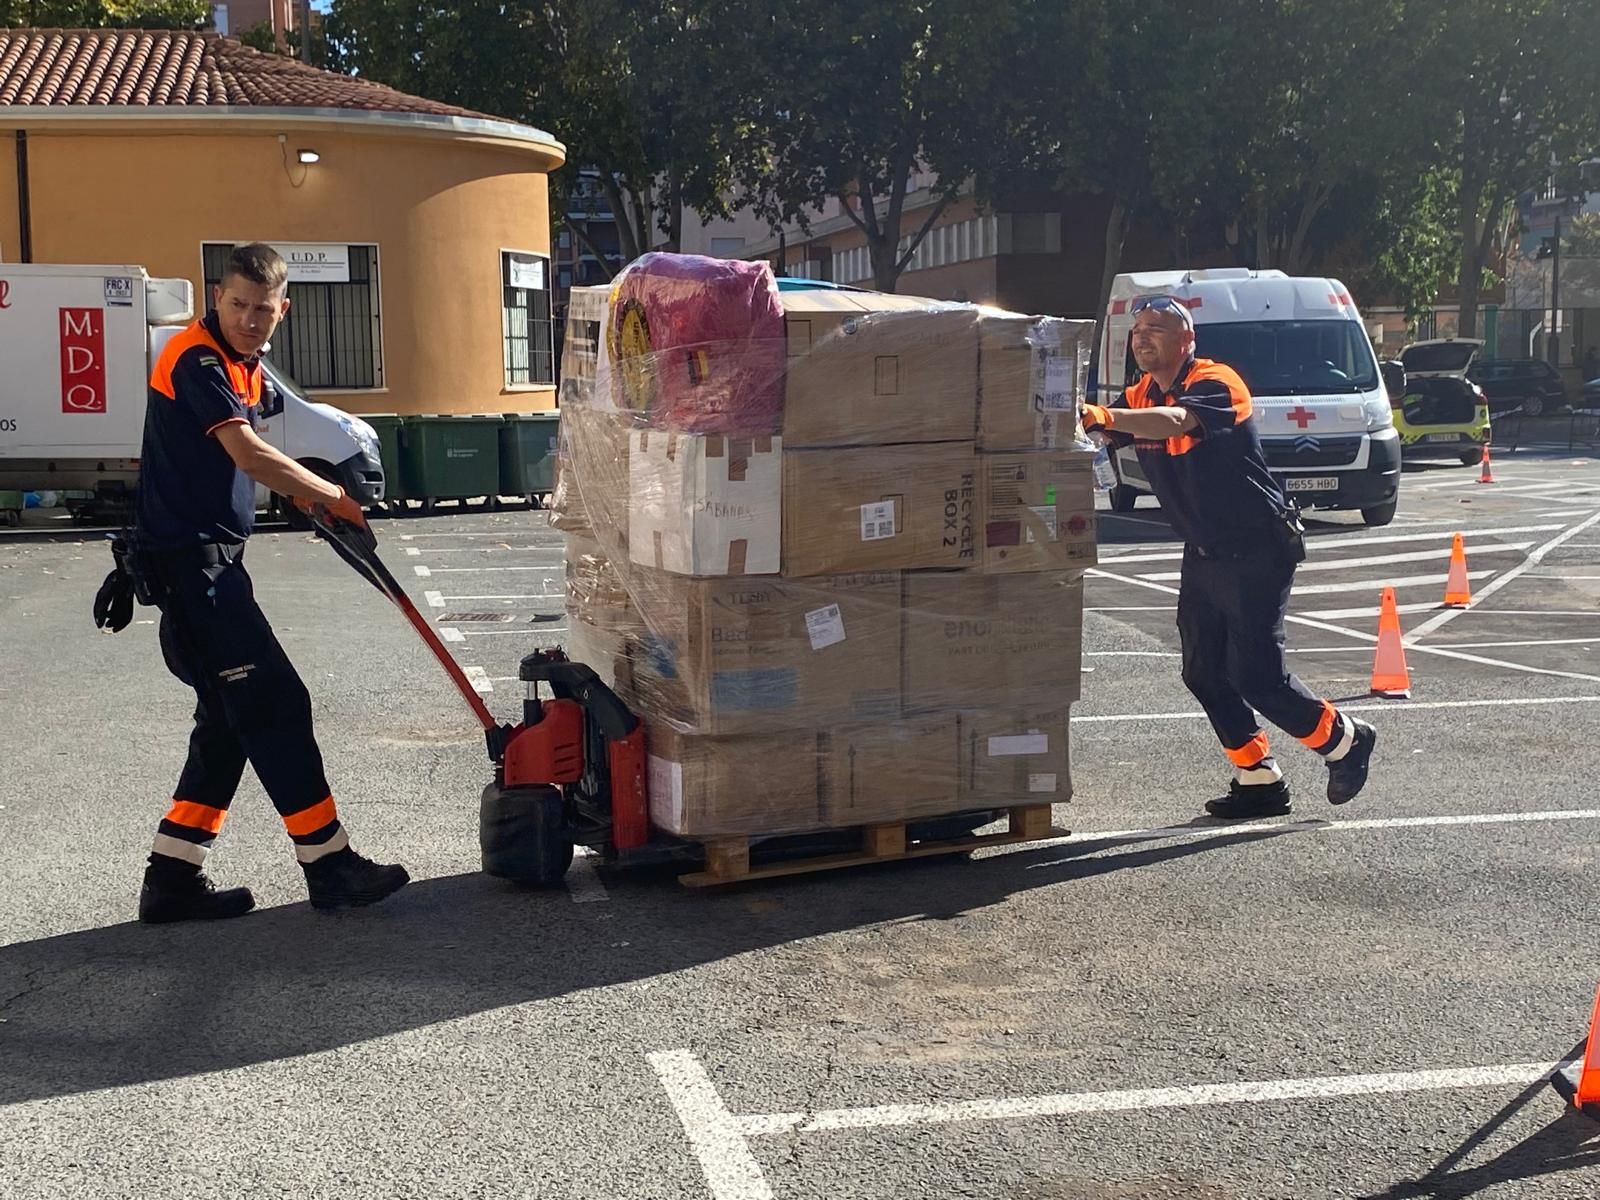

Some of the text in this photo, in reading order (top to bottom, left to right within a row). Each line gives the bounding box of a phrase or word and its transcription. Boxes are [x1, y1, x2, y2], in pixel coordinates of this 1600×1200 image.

[291, 252, 328, 263] U.D.P.
[1287, 478, 1337, 490] 6655 HBD
[943, 489, 958, 548] BOX 2
[959, 473, 976, 558] RECYCLE
